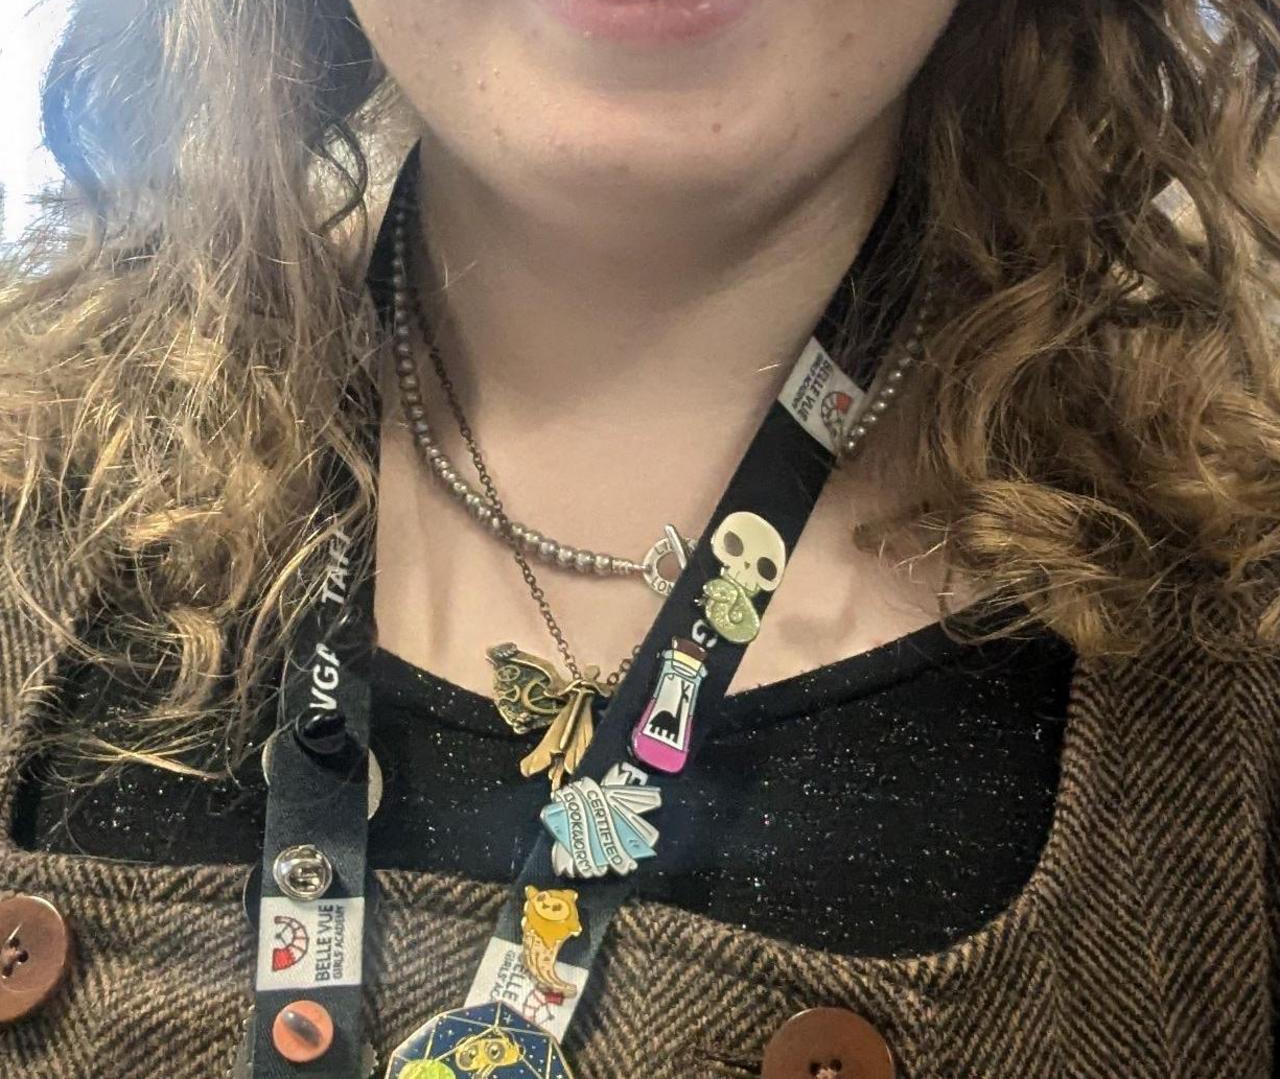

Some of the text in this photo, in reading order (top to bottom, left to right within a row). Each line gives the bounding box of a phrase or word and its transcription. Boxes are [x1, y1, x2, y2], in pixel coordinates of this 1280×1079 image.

[797, 395, 816, 422] VUE
[563, 791, 593, 873] BOOKWORM
[586, 789, 624, 866] CERTIFIED
[315, 904, 334, 982] BELLE VUE
